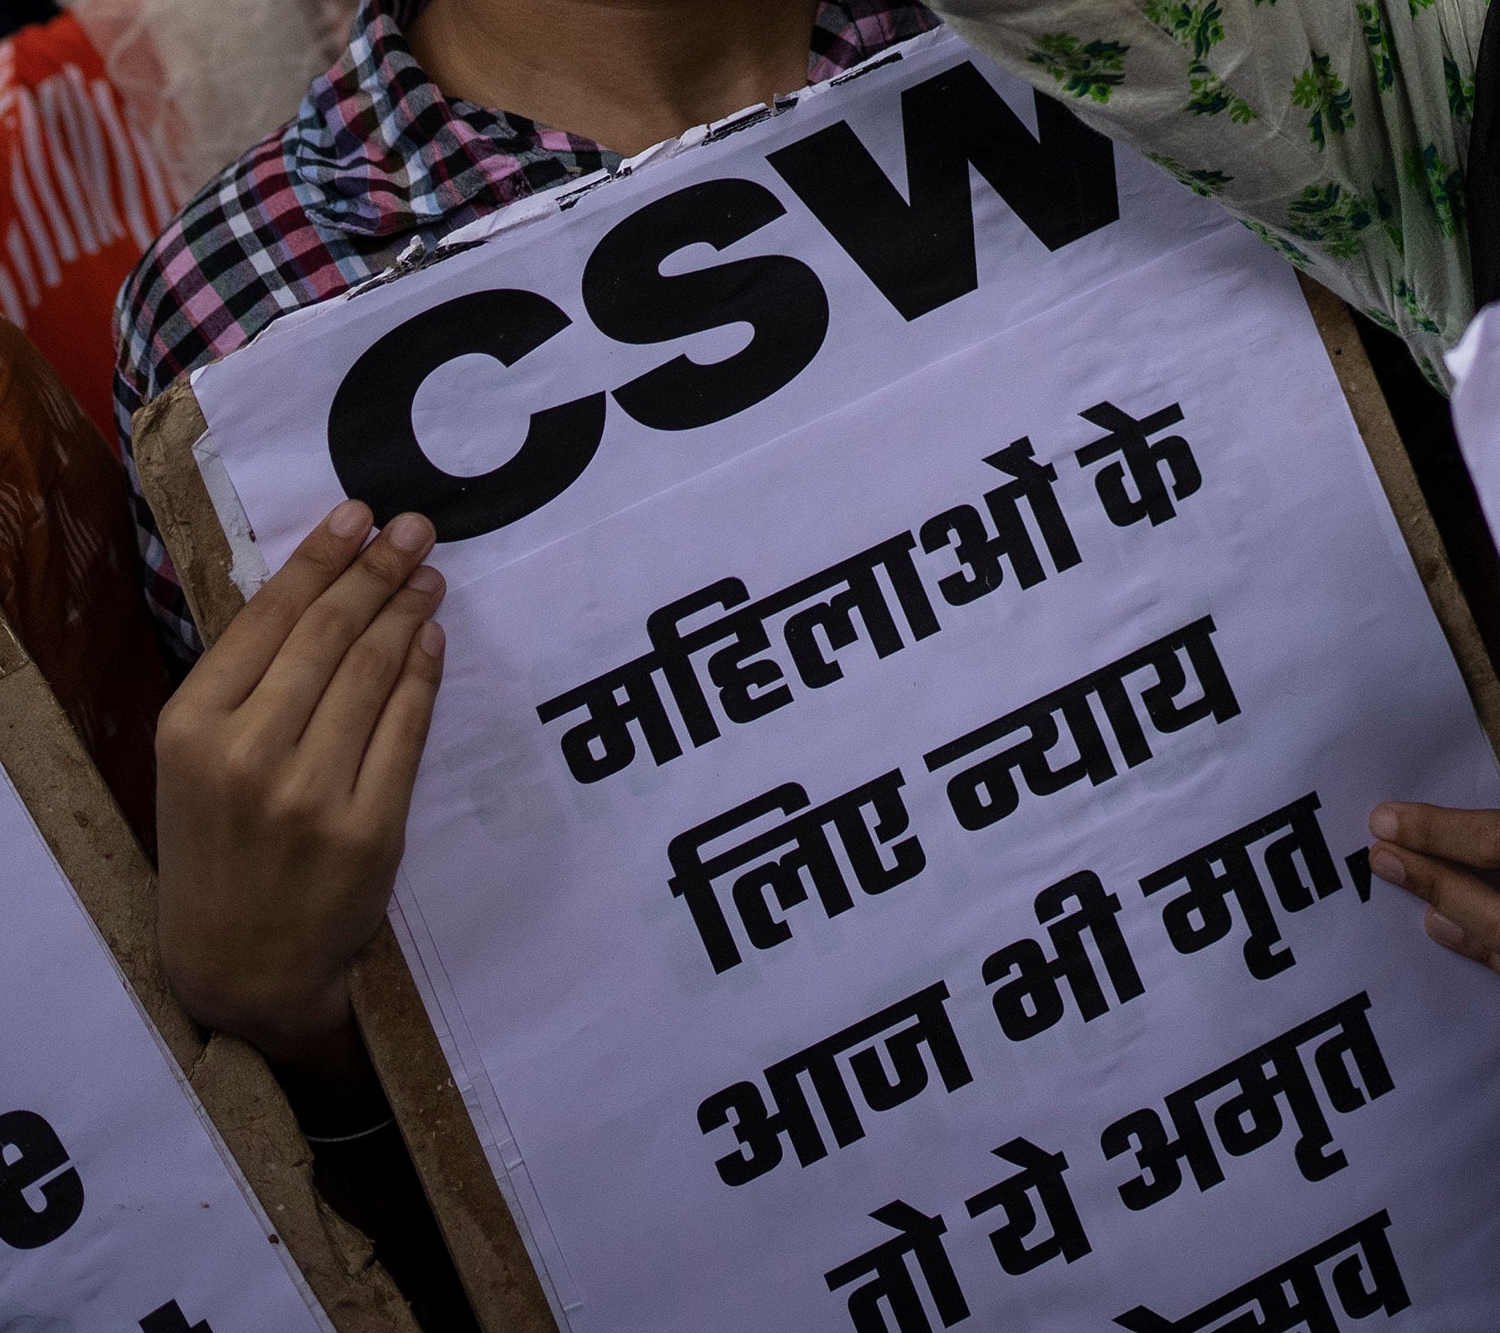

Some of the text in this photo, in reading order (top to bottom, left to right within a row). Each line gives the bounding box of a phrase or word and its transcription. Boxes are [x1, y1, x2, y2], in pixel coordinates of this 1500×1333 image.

[327, 61, 1122, 543] CSW
[536, 401, 1202, 784] महिलाओं के
[668, 614, 1241, 974] लिए न्याय
[697, 980, 973, 1186] आज
[982, 870, 1145, 1041] भी
[824, 990, 1395, 1333] तो ये अमृत
